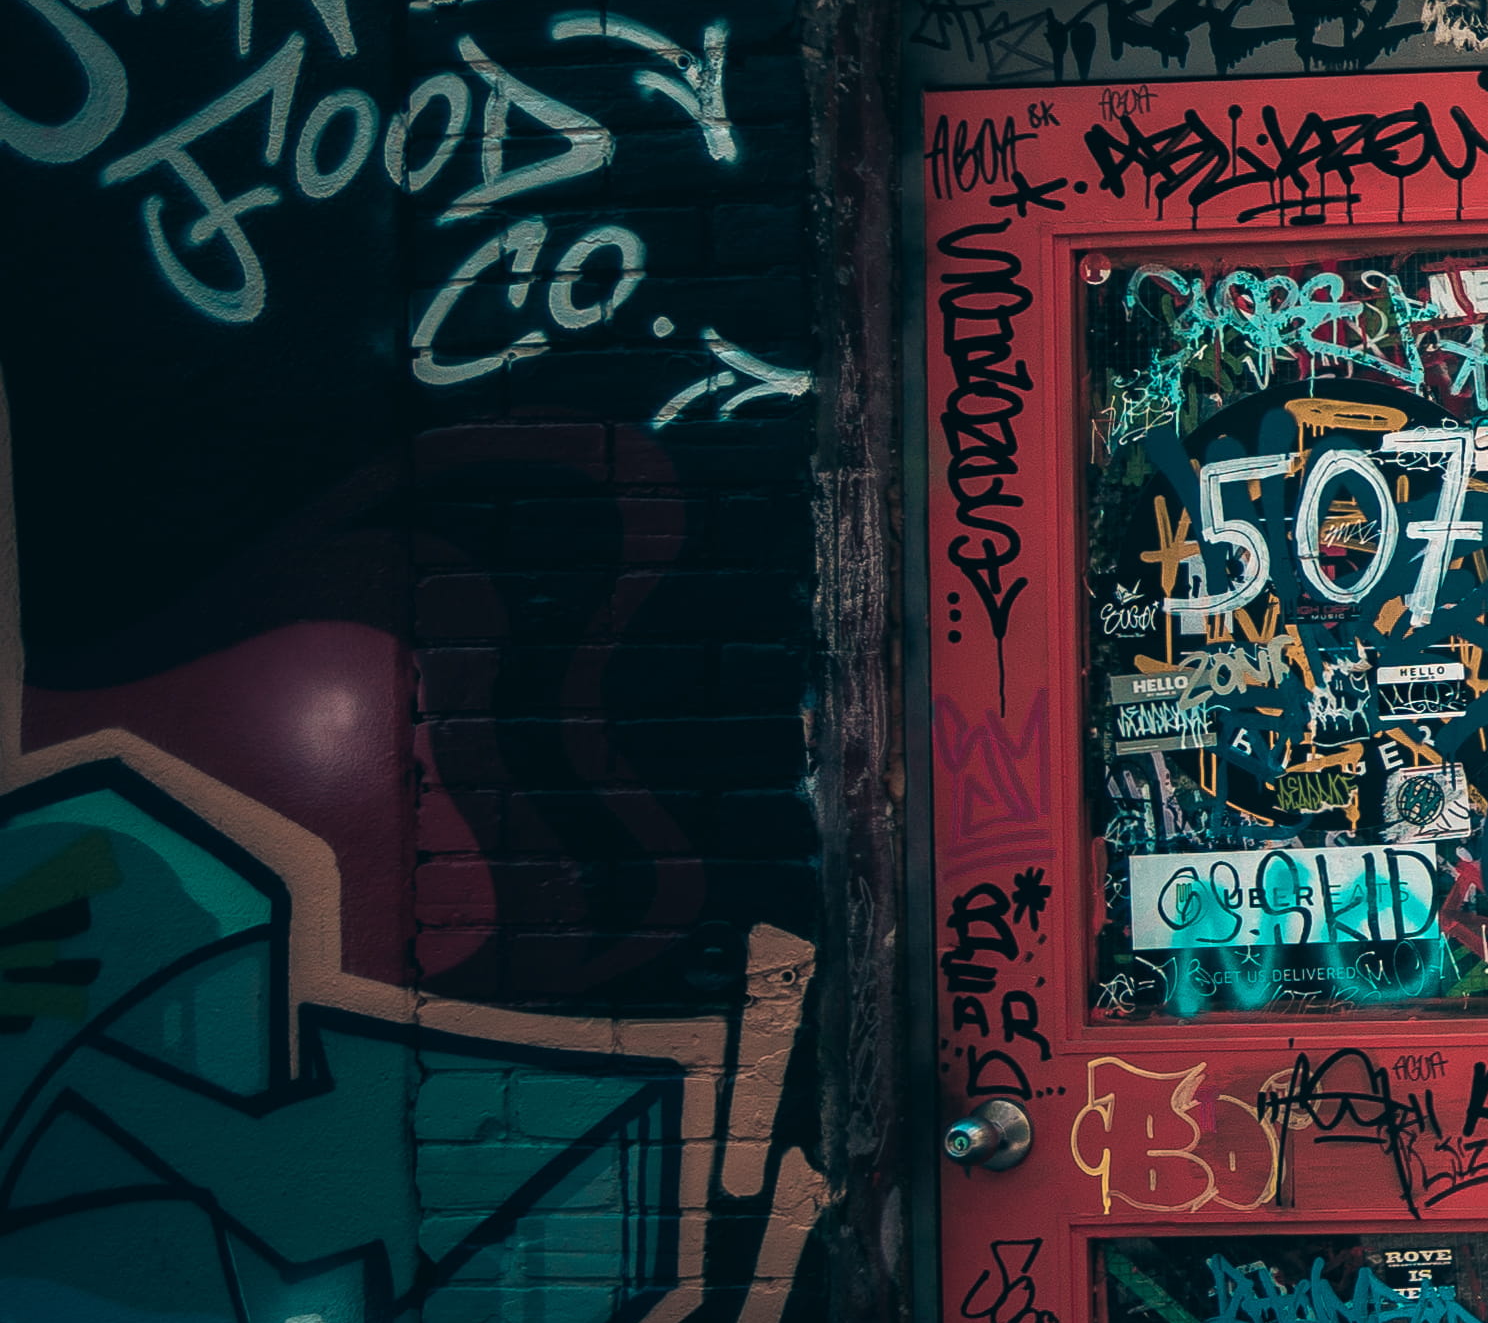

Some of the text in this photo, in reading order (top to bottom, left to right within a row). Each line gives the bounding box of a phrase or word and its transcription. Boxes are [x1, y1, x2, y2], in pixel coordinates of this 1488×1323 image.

[1163, 430, 1484, 628] 507
[1311, 612, 1345, 620] MUSIC
[1400, 665, 1446, 677] HELLO
[1132, 675, 1189, 694] HELLO
[1224, 884, 1314, 910] UBER
[1214, 964, 1357, 984] GET US DELIVERED
[1385, 1248, 1453, 1264] ROVE
[1408, 1269, 1433, 1282] IS
